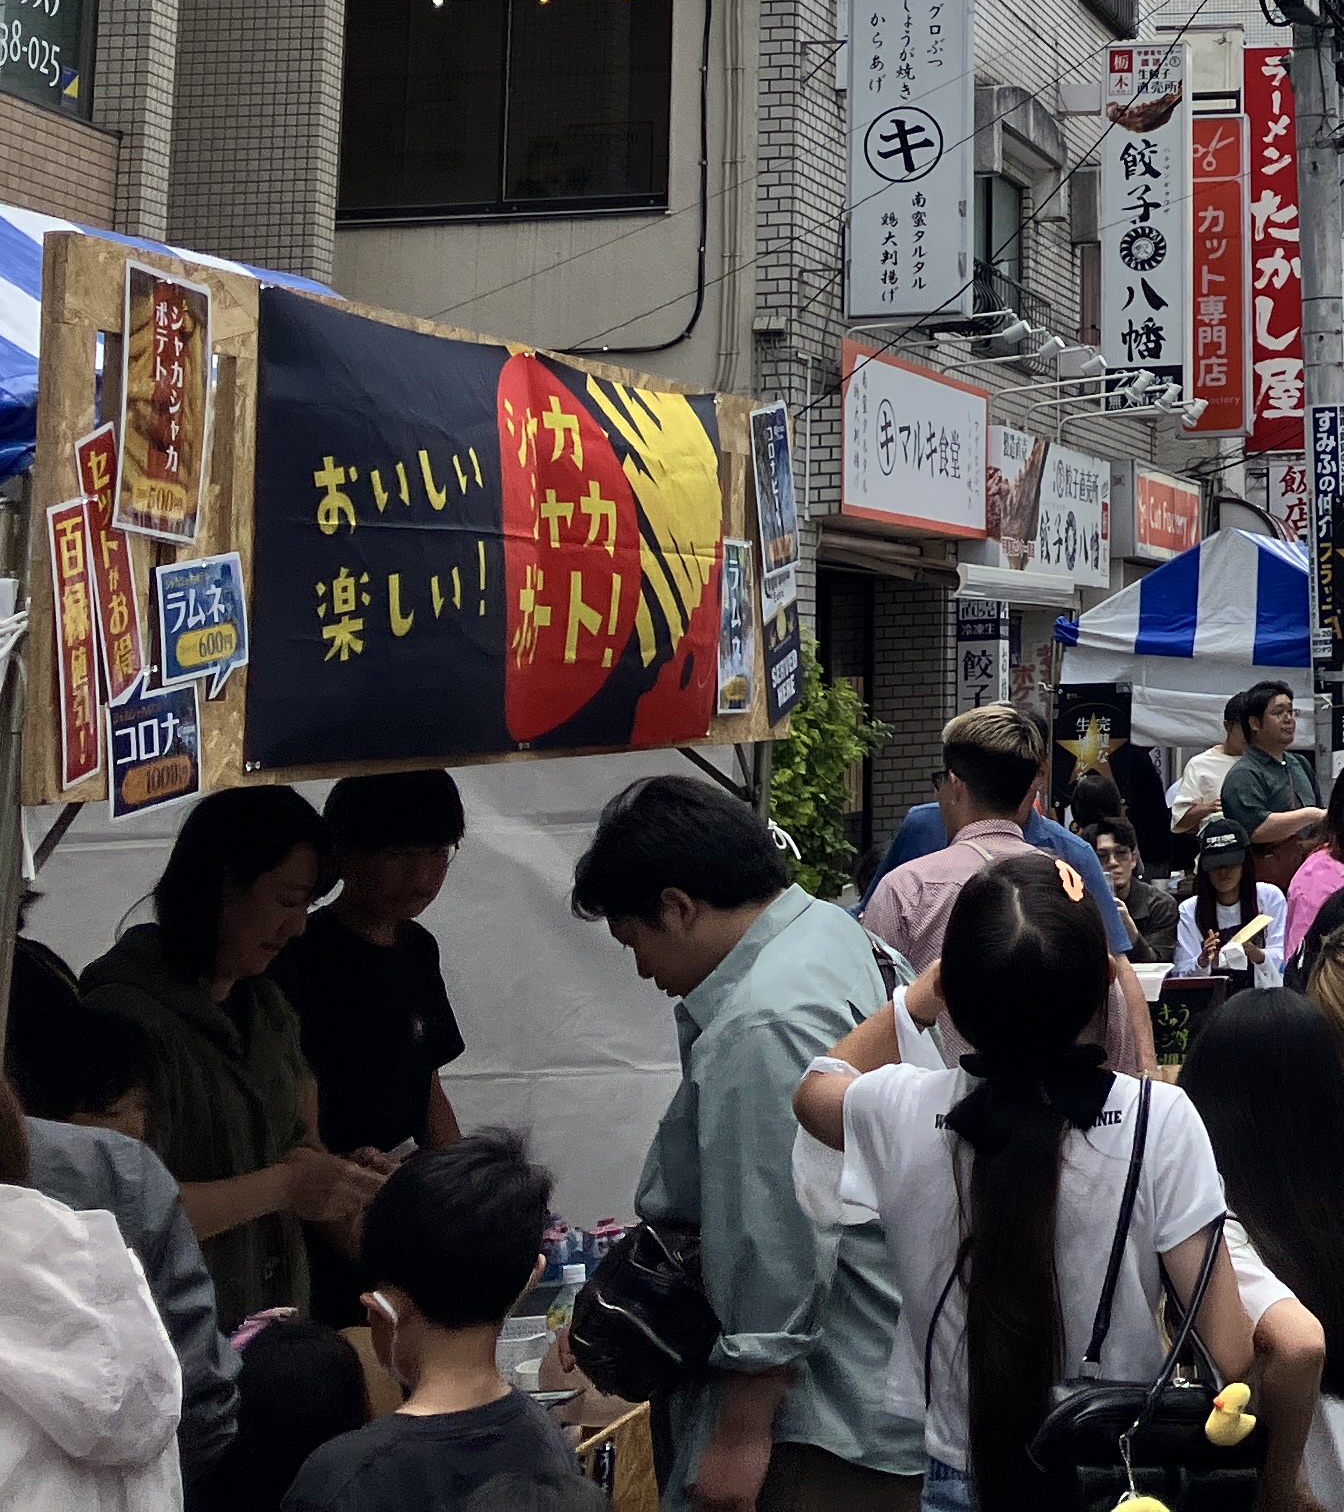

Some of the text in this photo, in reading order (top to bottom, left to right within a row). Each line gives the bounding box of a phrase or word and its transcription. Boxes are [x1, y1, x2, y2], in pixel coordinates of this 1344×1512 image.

[869, 13, 886, 93] からあげ
[1261, 56, 1293, 175] ラーメン
[1119, 139, 1162, 225] 餃子
[1121, 277, 1169, 363] 八幡
[1197, 206, 1229, 387] カット専門店
[1250, 189, 1304, 419] たかし屋
[155, 302, 169, 382] ポテト
[164, 305, 184, 473] シャカシャカ
[313, 447, 484, 535] おいしい
[898, 420, 961, 479] マルキ食堂
[166, 584, 225, 634] ラムネ
[315, 540, 486, 662] 楽しい!
[961, 622, 996, 636] 冷凍生
[962, 649, 994, 709] 餃子
[115, 712, 180, 765] コロナ
